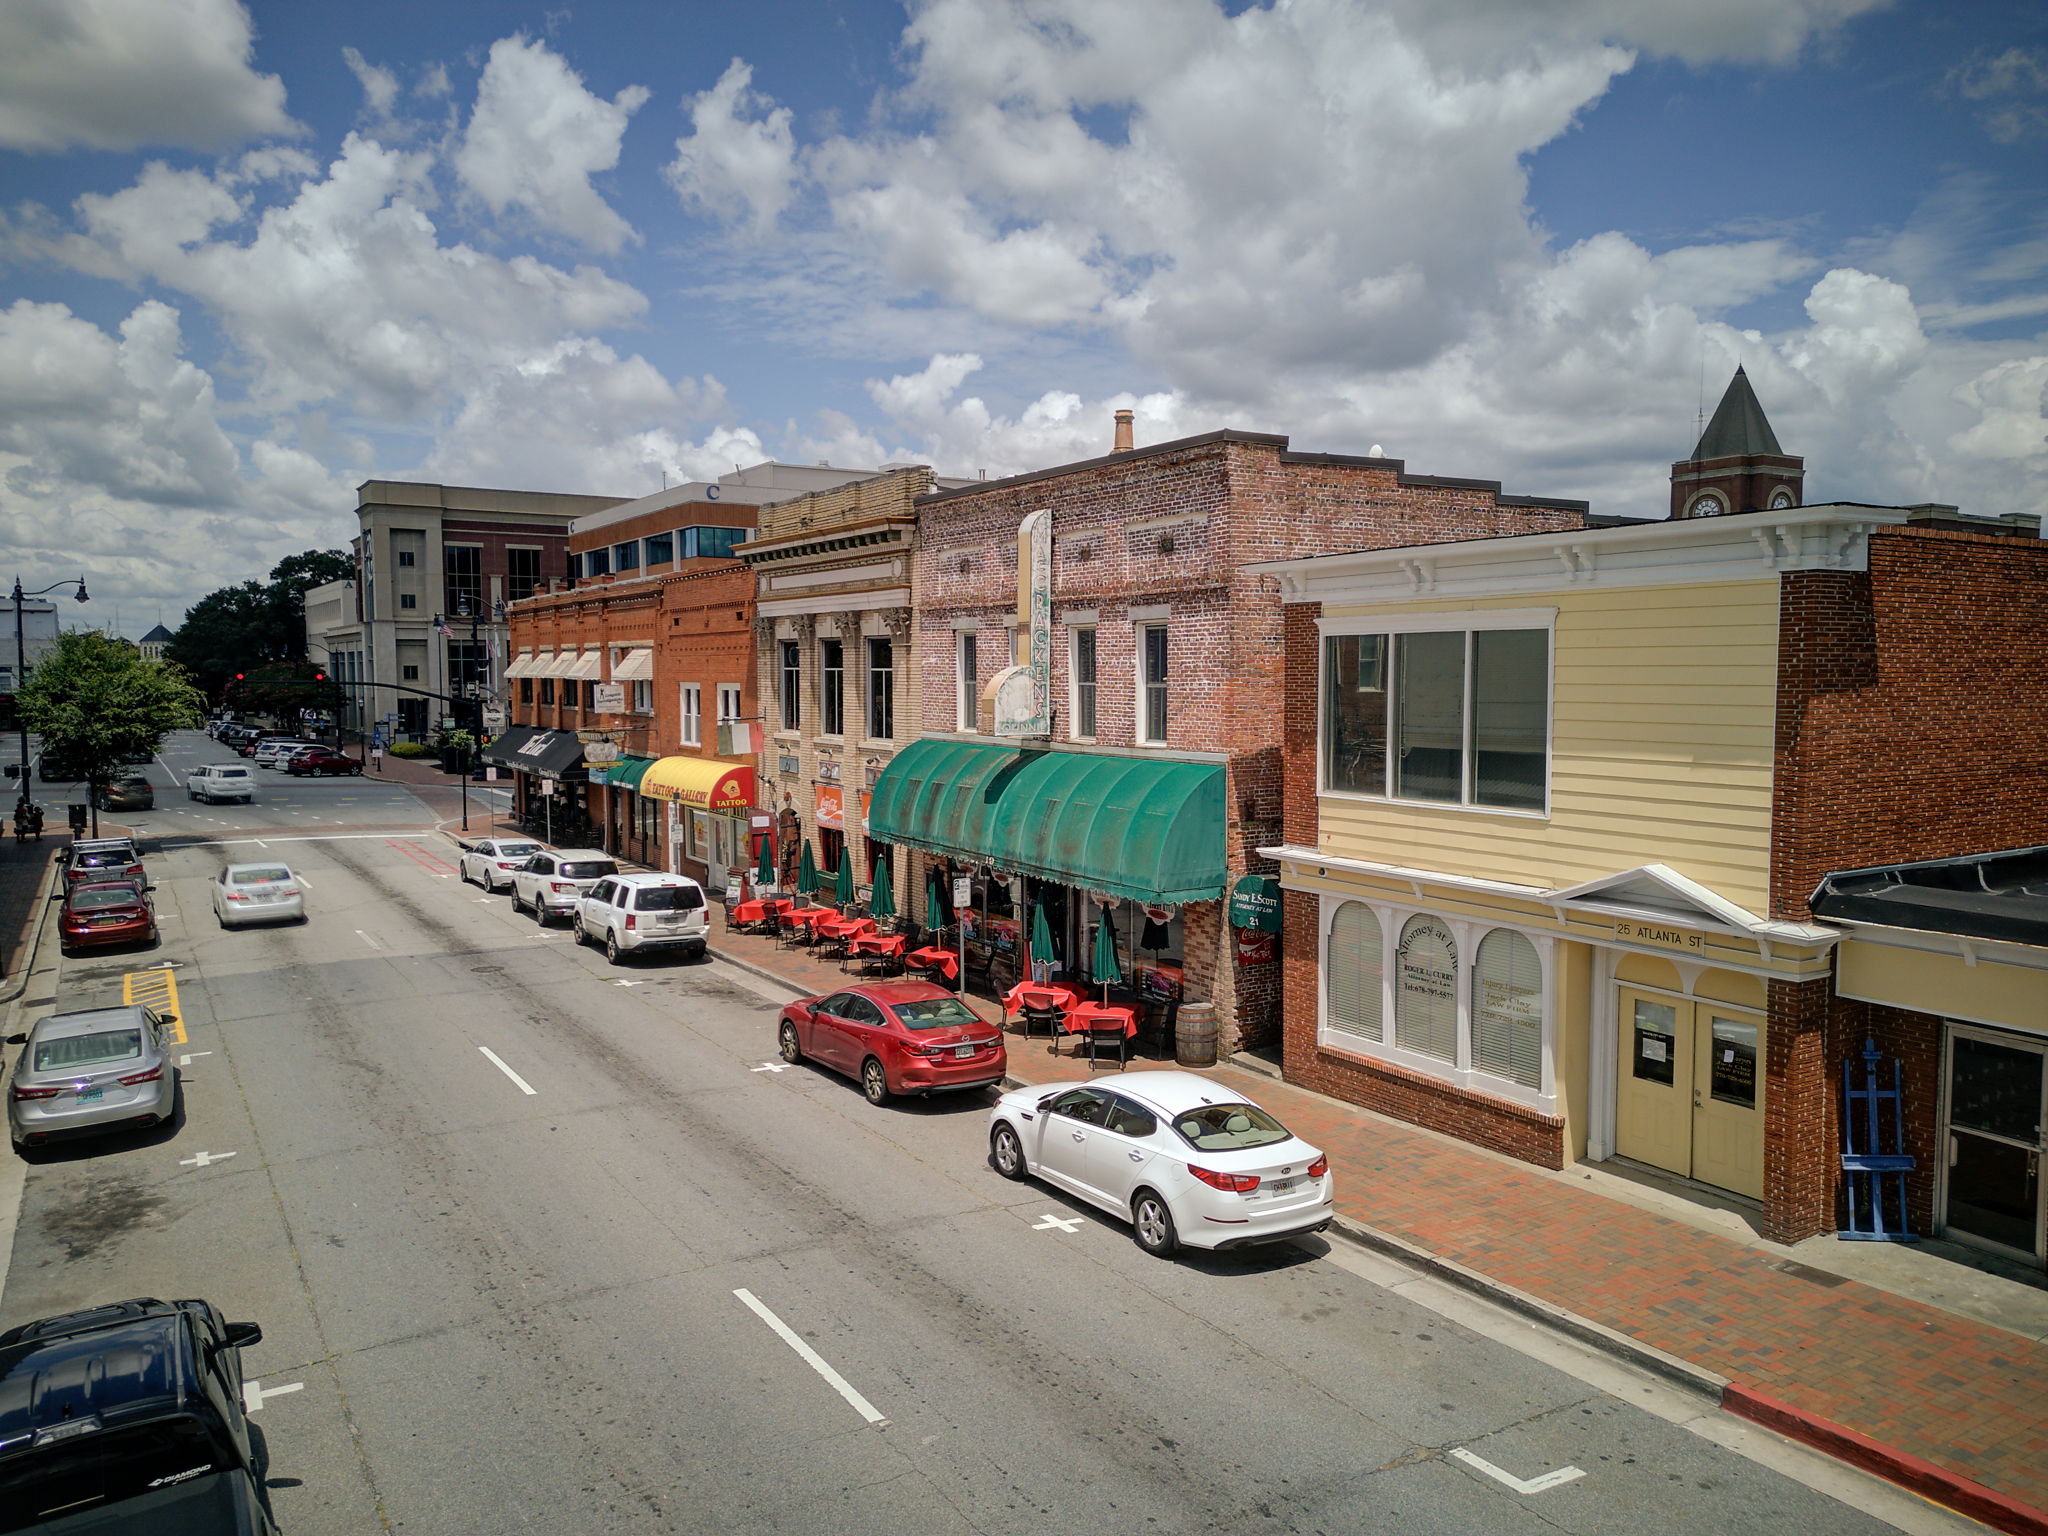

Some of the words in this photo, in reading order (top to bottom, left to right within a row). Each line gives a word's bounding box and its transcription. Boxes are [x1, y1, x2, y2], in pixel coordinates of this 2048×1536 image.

[706, 485, 720, 500] C
[716, 798, 748, 807] TATTOO
[1250, 917, 1259, 926] 21
[1617, 923, 1631, 935] 25
[1637, 927, 1682, 945] ATLANTA
[1688, 936, 1702, 948] ST
[1399, 925, 1434, 961] Attorney
[1435, 930, 1447, 942] at
[1445, 940, 1459, 973] Law
[1404, 964, 1425, 976] ROGER
[1432, 970, 1454, 982] CURRY
[164, 1464, 212, 1483] DIAMOND
